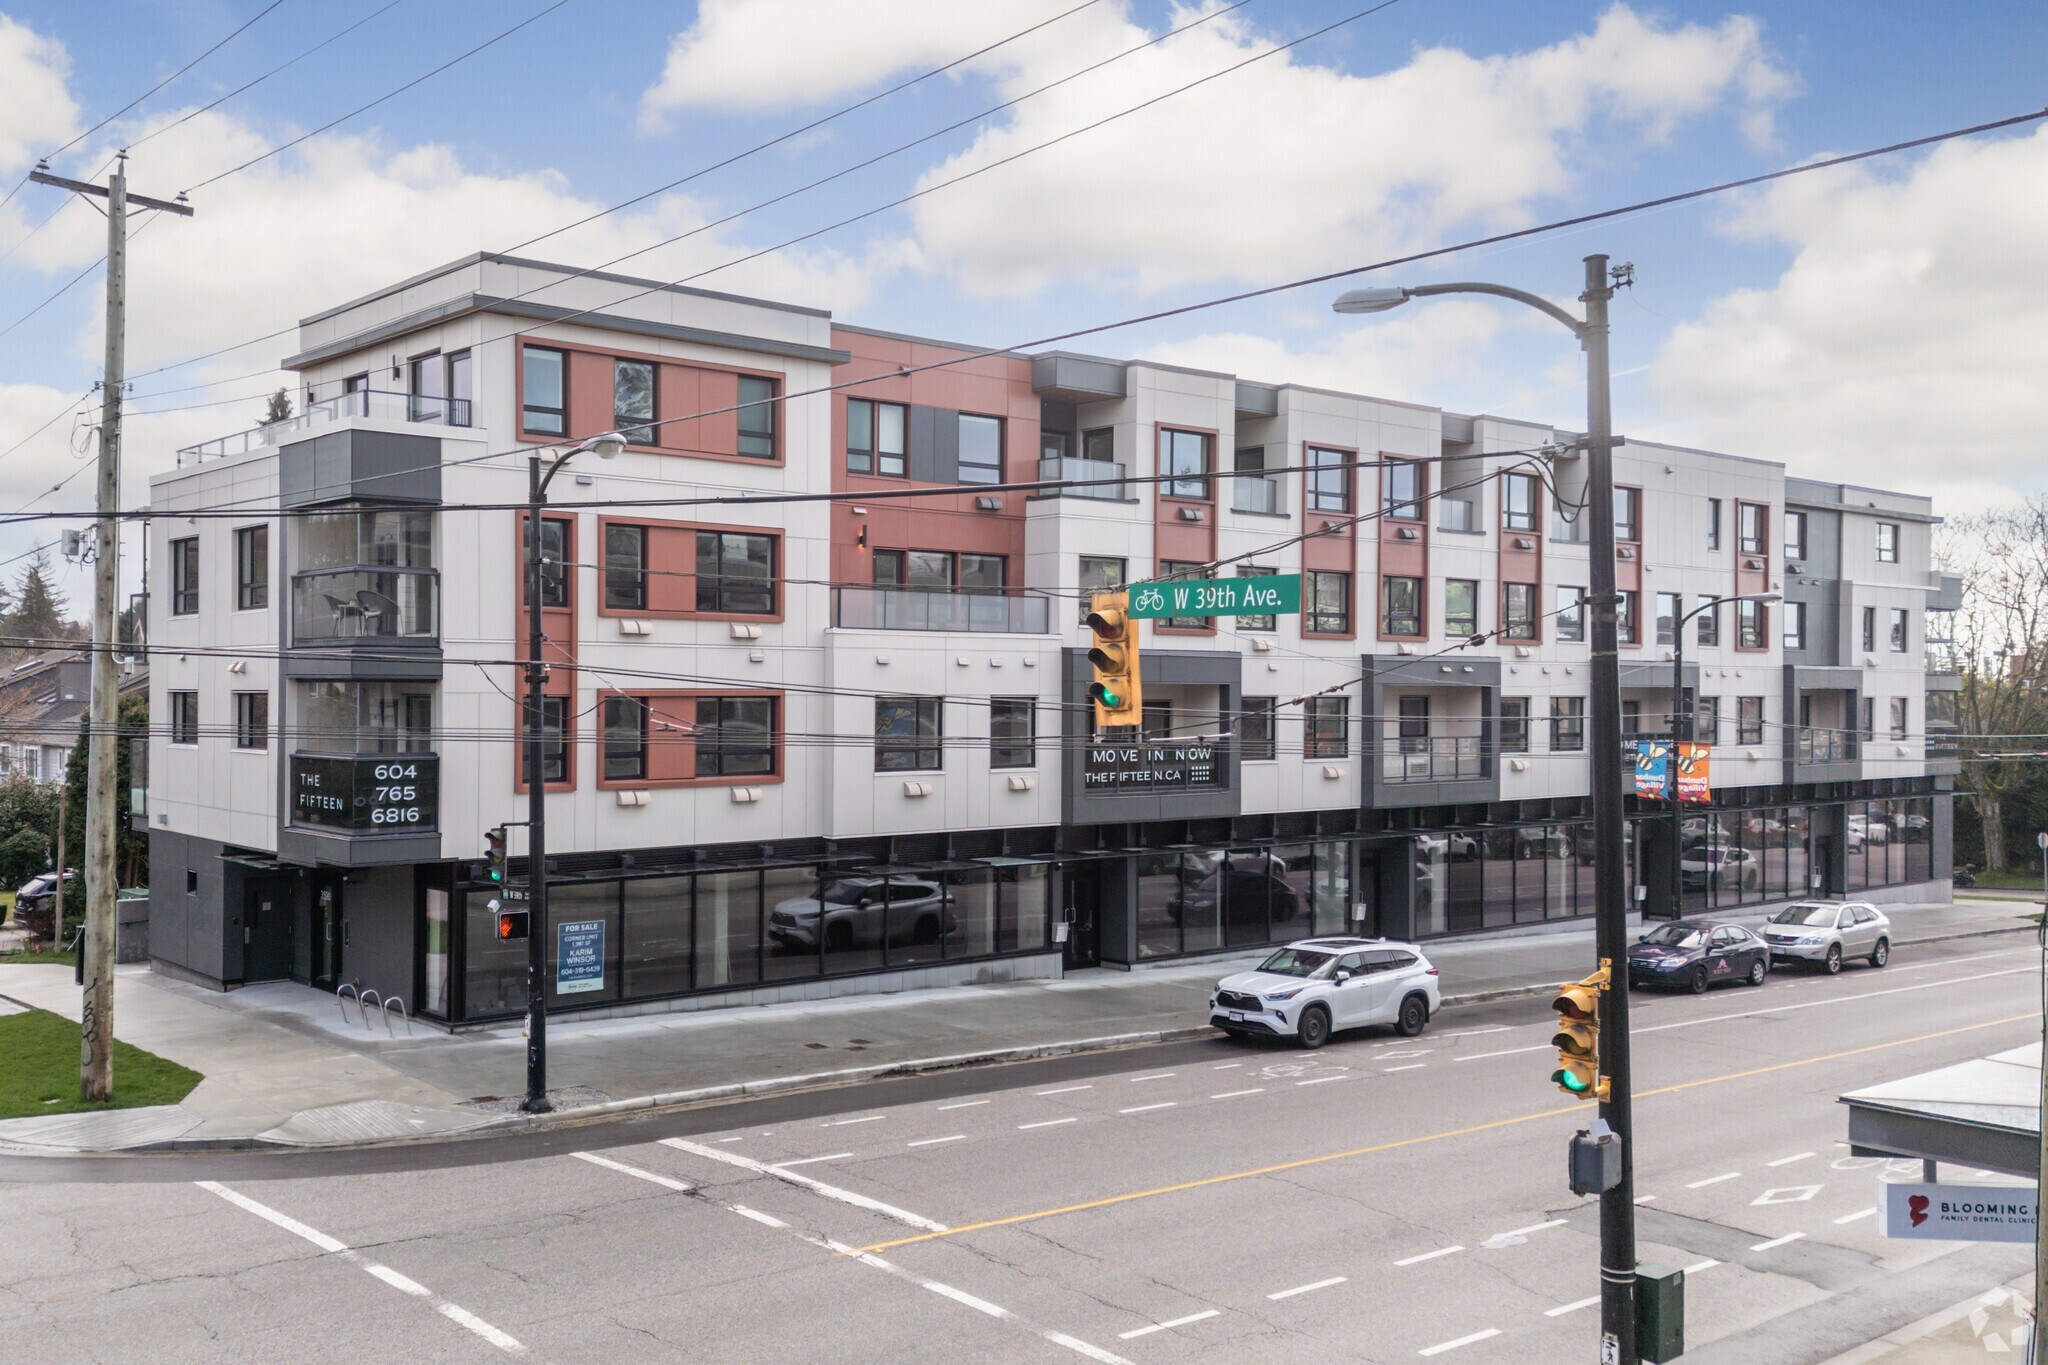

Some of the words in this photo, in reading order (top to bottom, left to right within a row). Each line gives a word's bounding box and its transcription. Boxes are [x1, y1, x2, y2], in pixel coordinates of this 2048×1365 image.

[1174, 588, 1189, 610] W
[1195, 584, 1236, 609] 39th
[1242, 584, 1282, 607] Ave.
[1093, 750, 1138, 763] MOVE
[1147, 749, 1164, 761] IN
[1175, 747, 1212, 761] NOW
[374, 764, 418, 780] 604
[300, 773, 320, 787] THE
[375, 786, 416, 802] 765
[300, 794, 343, 811] FIFTEEN
[371, 807, 420, 824] 6816
[565, 925, 580, 933] FOR
[581, 923, 598, 931] SALE
[564, 934, 586, 942] CORNER
[566, 955, 596, 965] WINSOR
[569, 948, 593, 957] KARIM
[1941, 1202, 2029, 1215] BLOOMING
